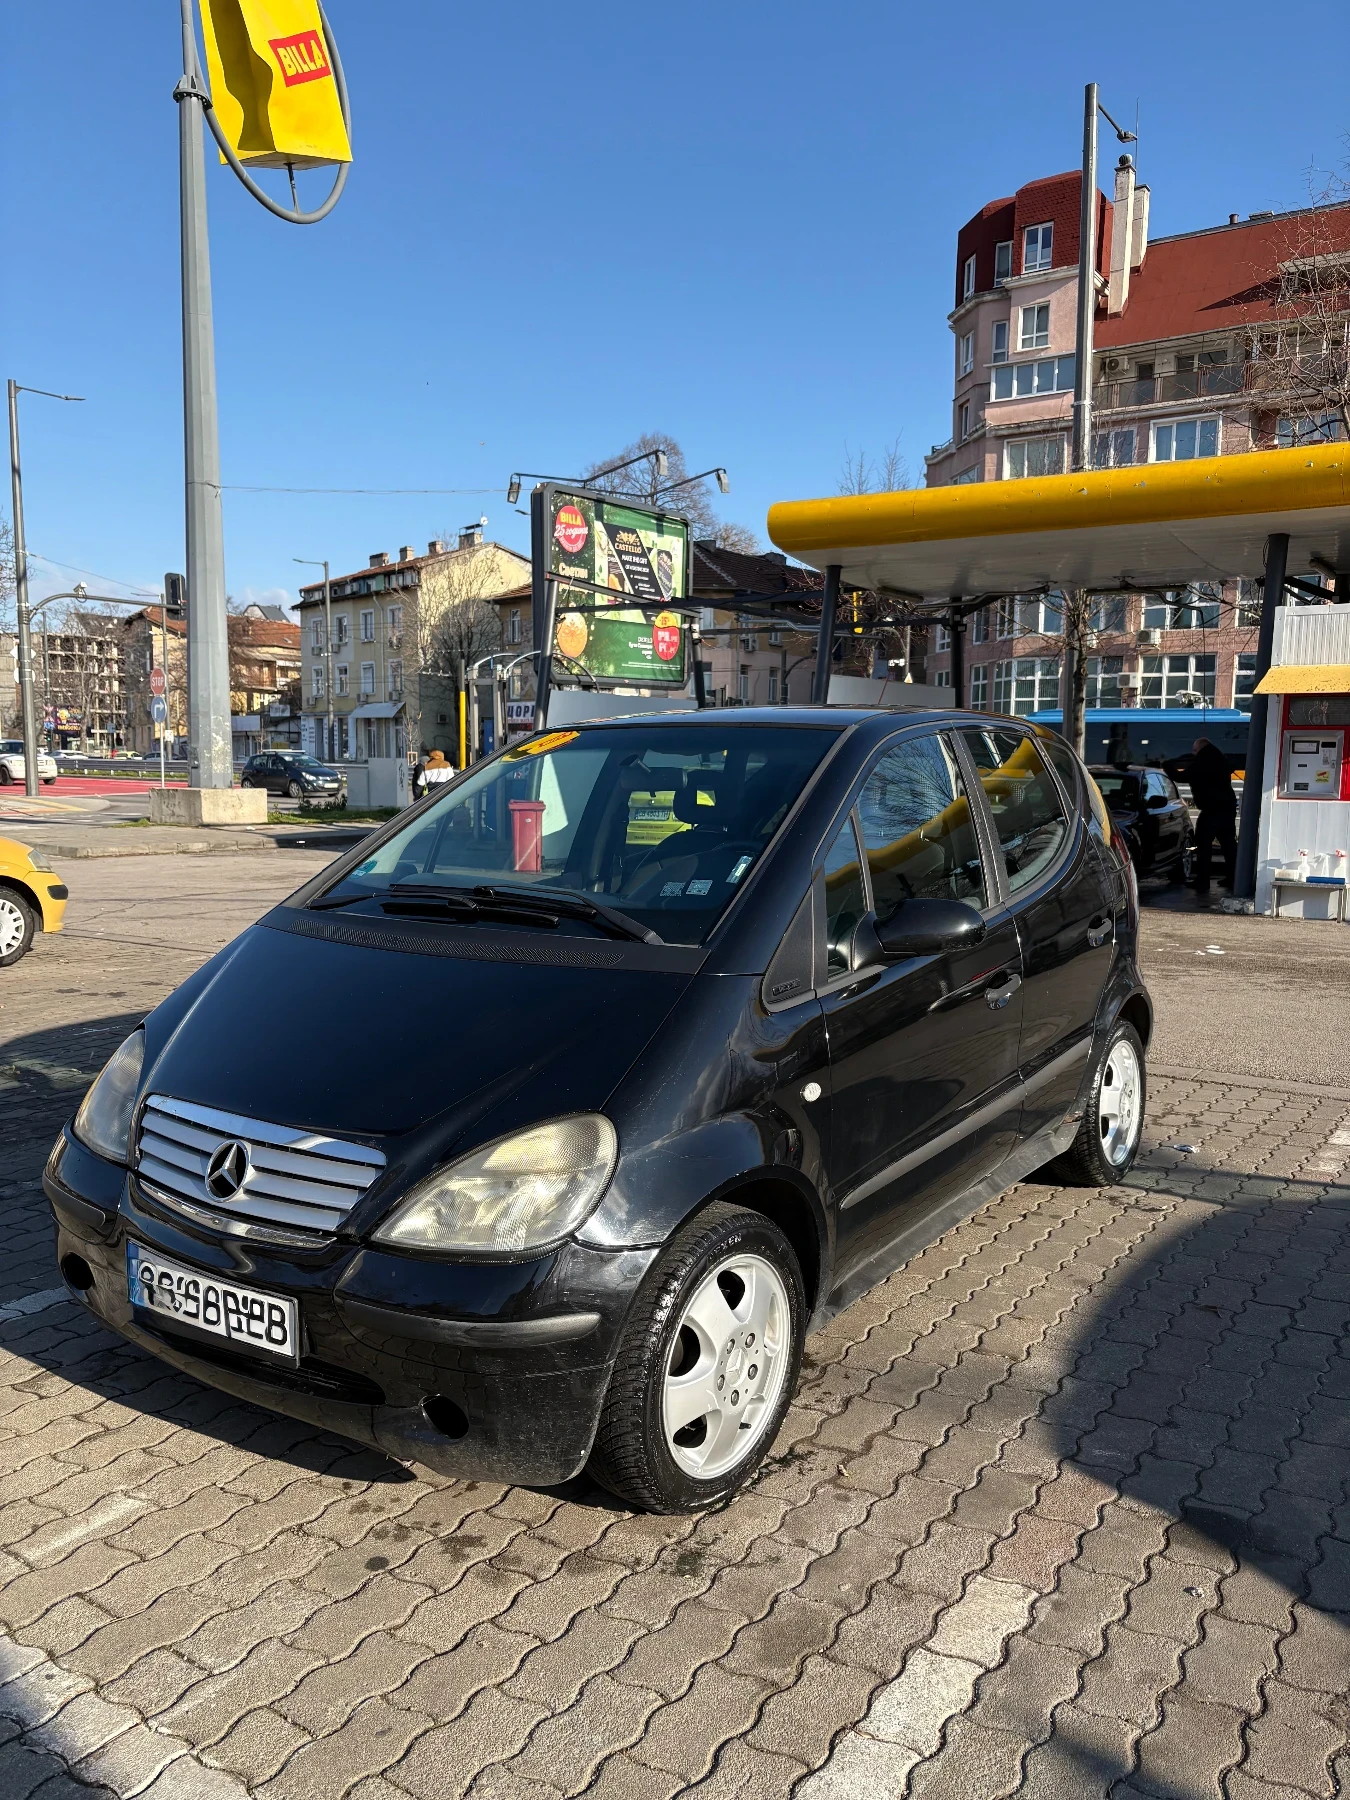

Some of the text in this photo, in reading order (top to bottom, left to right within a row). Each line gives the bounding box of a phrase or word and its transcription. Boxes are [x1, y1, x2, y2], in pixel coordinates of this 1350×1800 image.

[277, 39, 326, 77] BILLA
[559, 511, 582, 526] BILLA
[553, 524, 566, 537] 25
[614, 543, 642, 554] CASTELLO
[151, 676, 164, 687] STOP
